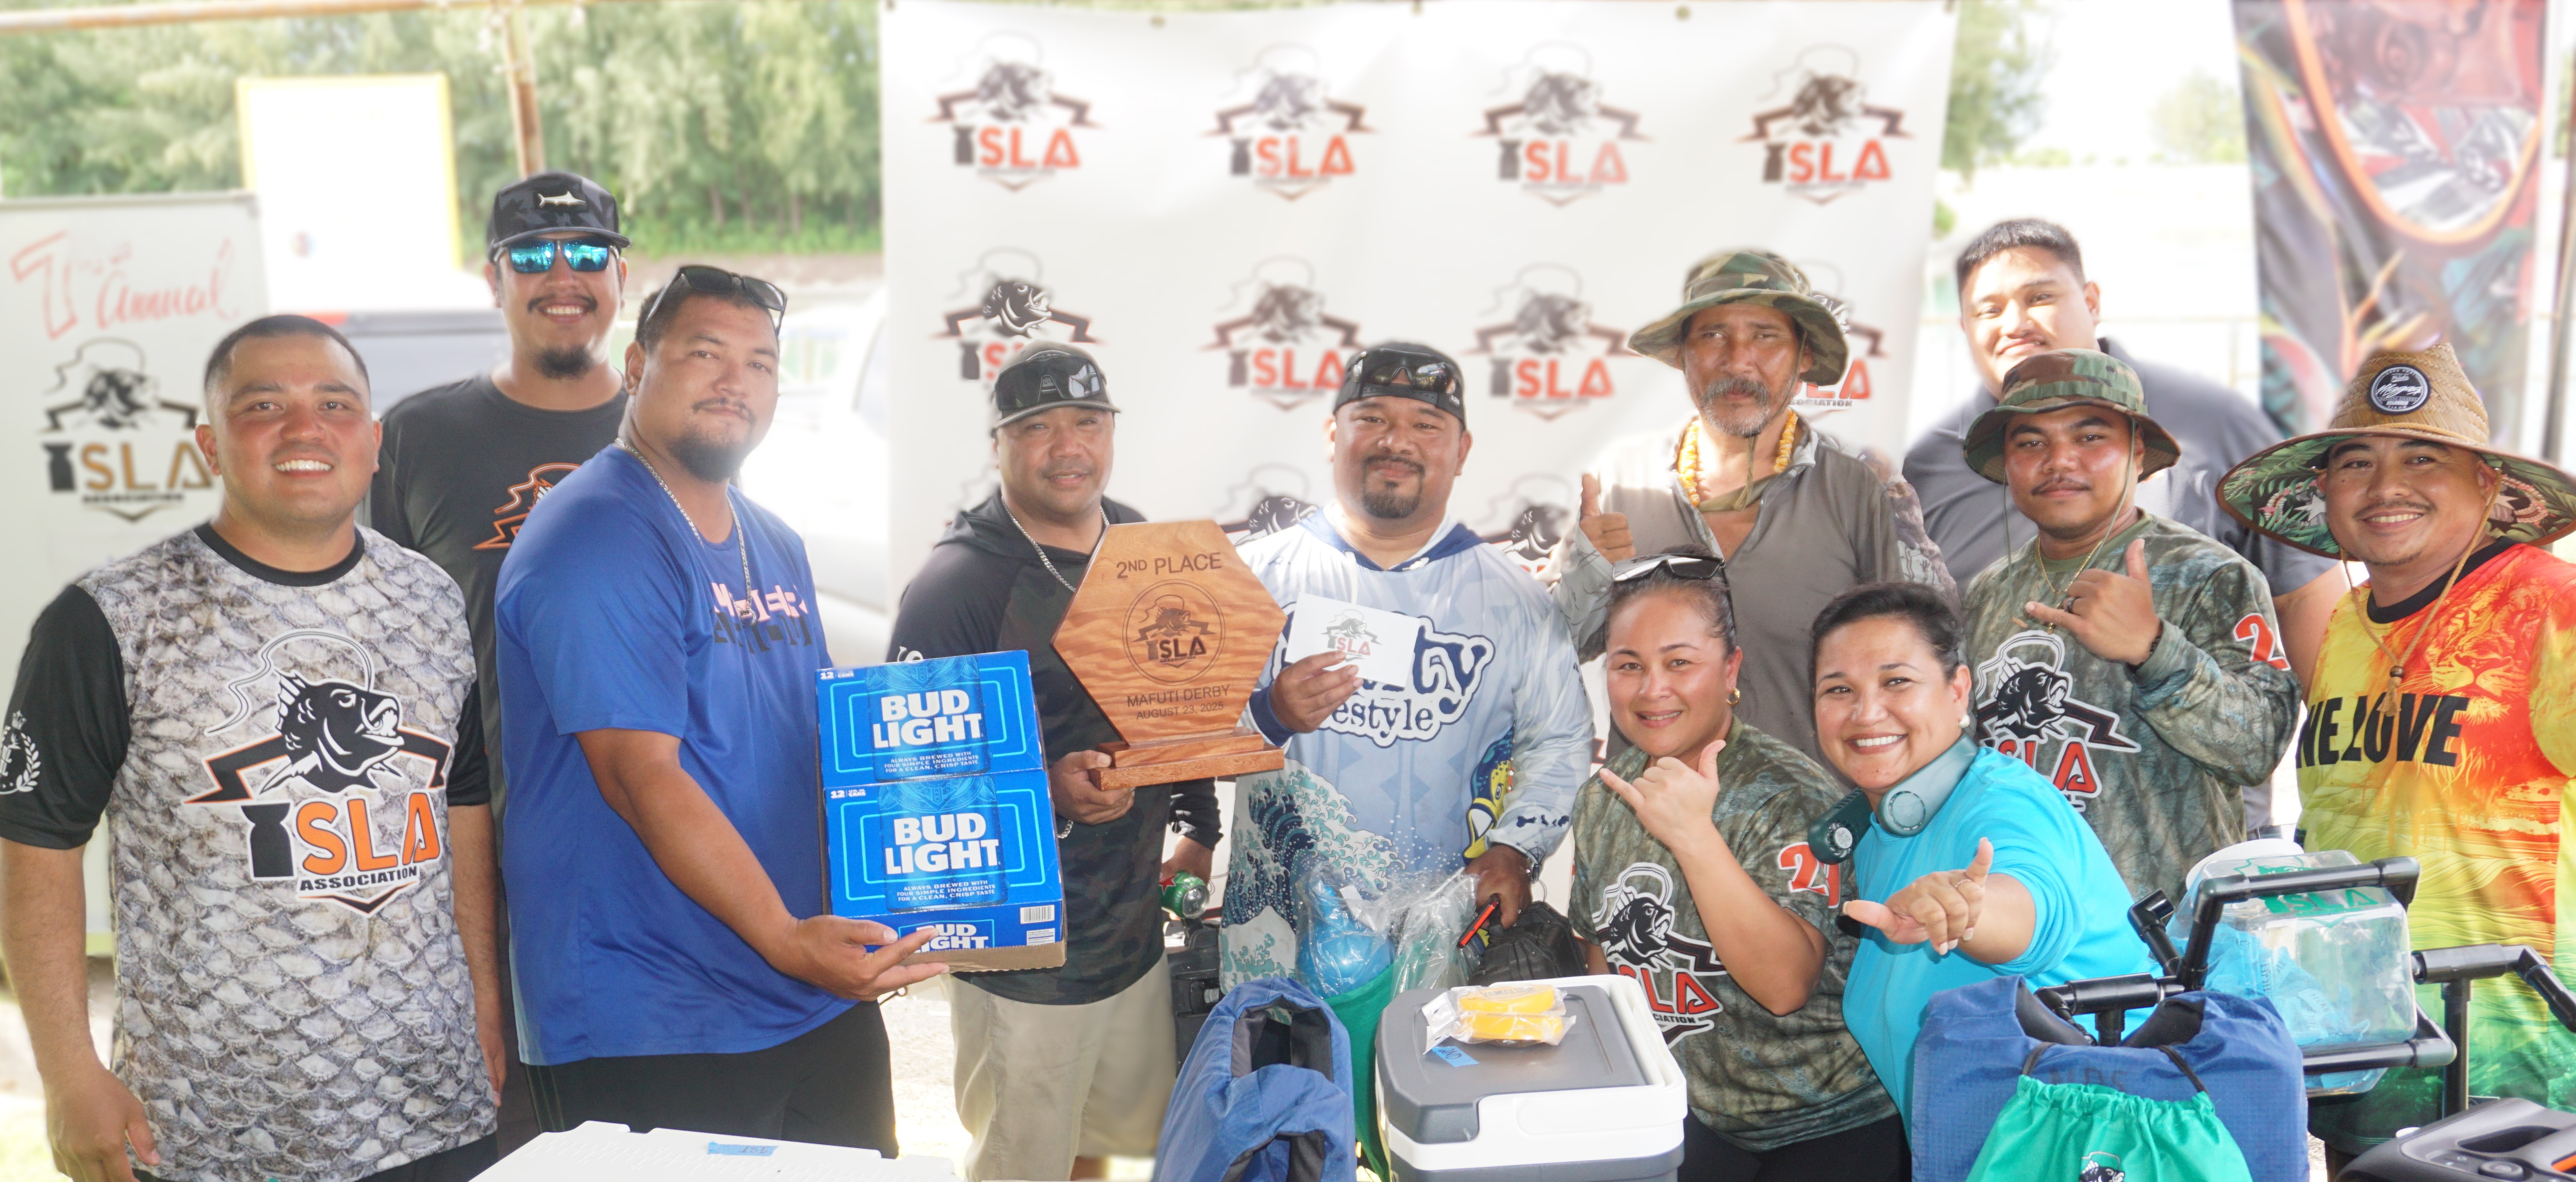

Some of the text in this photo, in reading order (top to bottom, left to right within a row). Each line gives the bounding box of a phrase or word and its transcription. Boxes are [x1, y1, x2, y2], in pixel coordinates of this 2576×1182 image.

[1116, 552, 1222, 579] 2ND PLACE
[820, 671, 834, 680] 12
[881, 690, 969, 721] BUD
[1127, 684, 1230, 707] MAFUTI DERBY
[1136, 701, 1224, 720] AUGUST 23, 2025
[1332, 699, 1433, 738] estyle
[873, 713, 982, 748] LIGHT
[2341, 691, 2469, 767] LOVE
[933, 755, 979, 764] INGREDIENTS
[831, 790, 845, 799] 12
[894, 813, 986, 845] BUD
[885, 839, 999, 875] LIGHT
[299, 865, 417, 891] ASSOCIATION
[948, 884, 996, 893] INGREDIENTS
[916, 924, 977, 936] UD
[1653, 1014, 1696, 1024] CIATION
